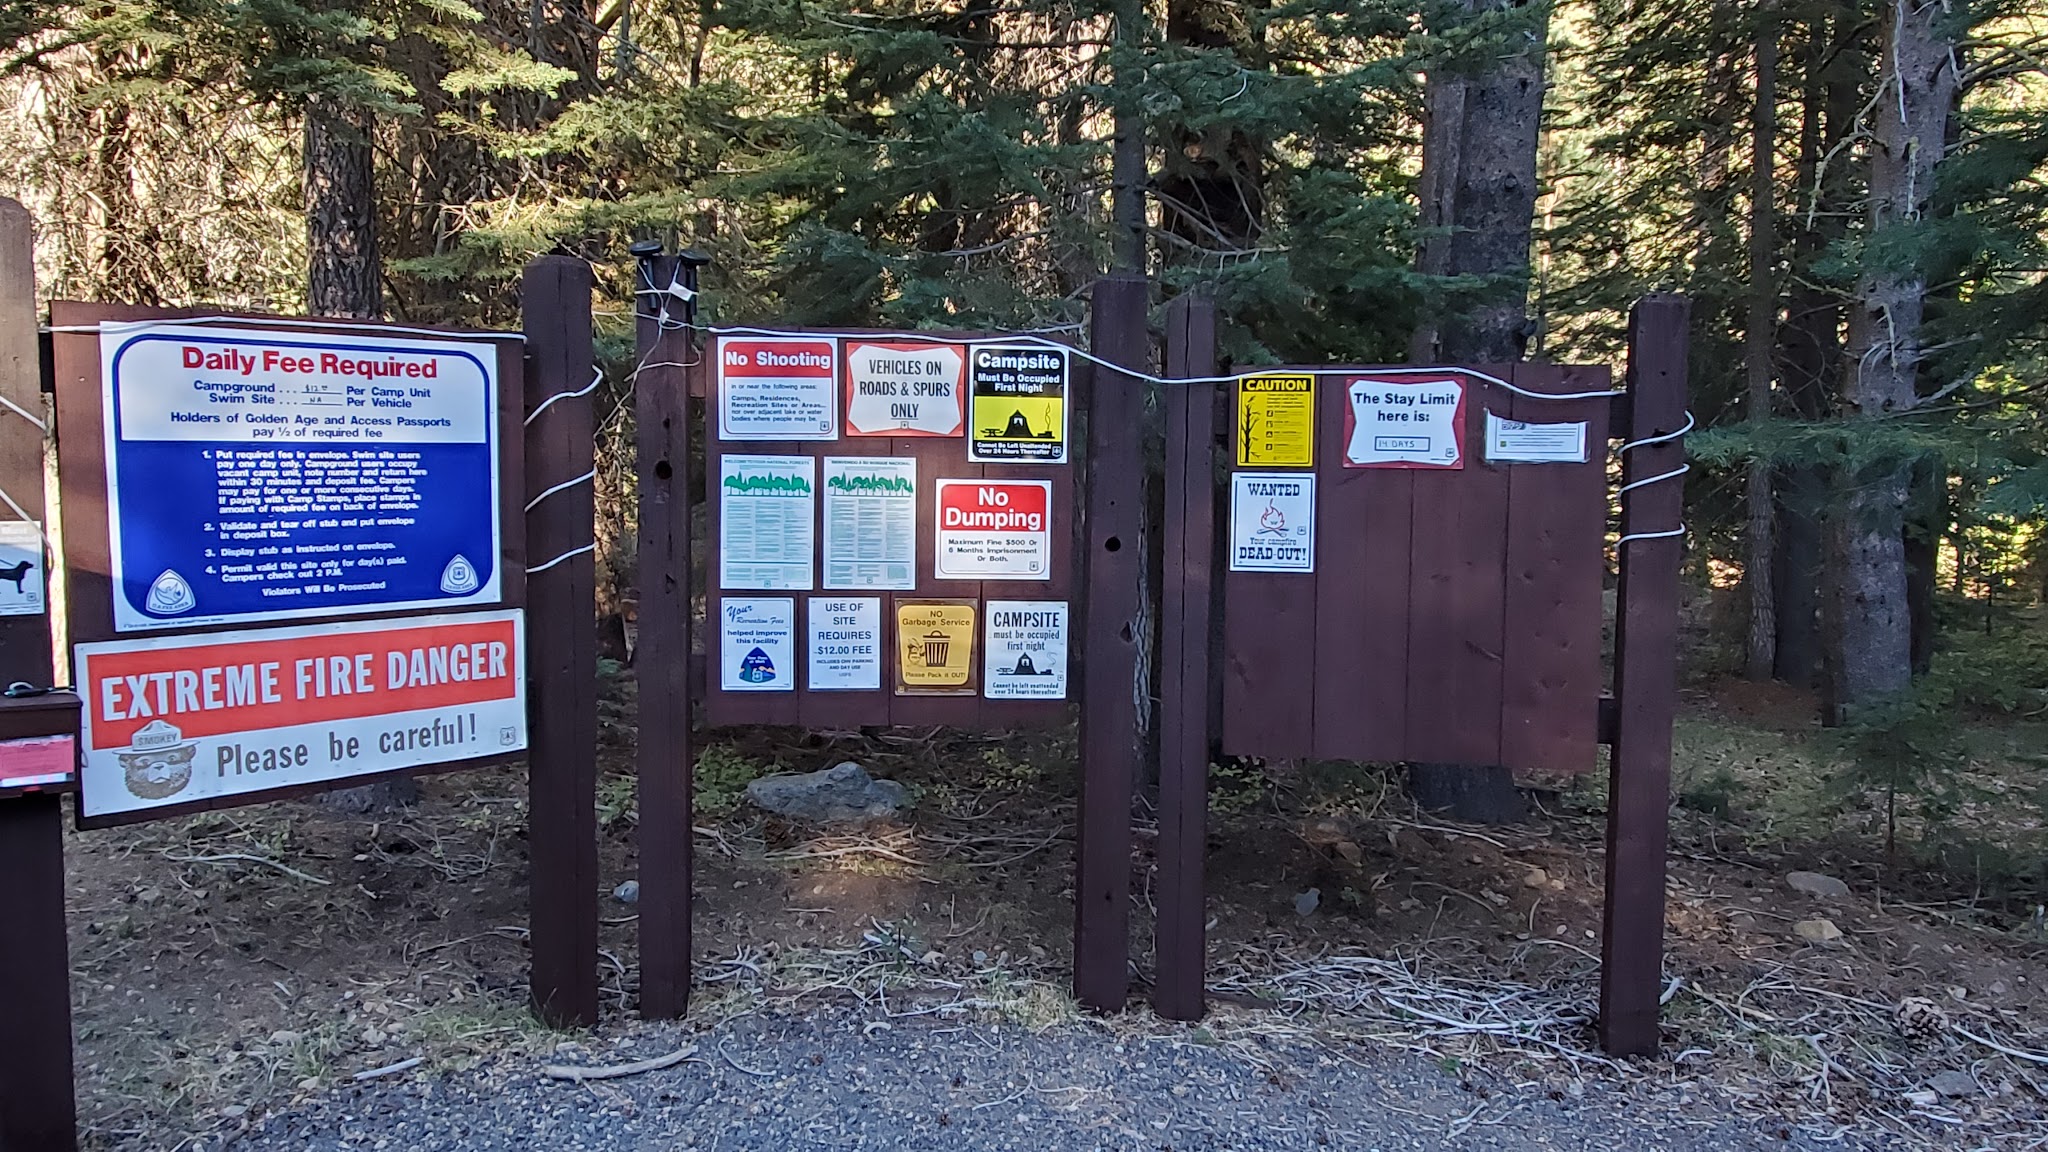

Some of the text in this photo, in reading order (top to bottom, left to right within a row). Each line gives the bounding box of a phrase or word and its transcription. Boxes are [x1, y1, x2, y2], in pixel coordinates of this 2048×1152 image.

[182, 346, 437, 380] Daily Fee Required
[725, 351, 831, 370] No Shooting
[869, 359, 942, 376] VEHICLES ON
[978, 352, 1060, 372] Campsite
[977, 372, 1060, 384] Must Be Occupied
[1246, 379, 1307, 391] CAUTION
[194, 380, 275, 393] Campground
[346, 386, 366, 396] Per
[371, 387, 404, 398] Camp
[410, 388, 431, 398] Unit
[773, 383, 798, 391] following
[859, 381, 951, 397] ROADS & SPURS
[994, 383, 1043, 394] First Night
[209, 393, 245, 403] Swim
[251, 394, 275, 404] Site
[347, 397, 366, 407] Per
[372, 398, 412, 408] Vehicle
[1354, 392, 1456, 406] The Stay Limit
[890, 403, 919, 418] ONLY
[1377, 410, 1430, 422] here is:
[171, 412, 451, 428] Holders of Golden Age and Access Passports
[253, 428, 274, 438] pay
[294, 427, 306, 437] of
[313, 428, 359, 439] required
[365, 429, 383, 437] fee
[1391, 440, 1415, 448] DAYS
[978, 487, 1009, 506] No
[1247, 483, 1300, 496] WANTED
[204, 517, 415, 531] 2. Validate and tear off stub and put envelope
[945, 507, 1041, 531] Dumping
[220, 529, 290, 540] in deposit box.
[1249, 537, 1297, 546] Your campfire
[204, 549, 216, 558] 3.
[221, 548, 255, 557] Display
[258, 546, 279, 555] stub
[296, 544, 340, 553] instructed
[356, 542, 396, 551] envelope.
[987, 547, 1037, 555] Imprisonment
[1239, 546, 1307, 561] DEAD-OUT!
[205, 566, 217, 574] 4.
[221, 564, 253, 573] Permit
[256, 563, 278, 571] valid
[280, 562, 297, 570] this
[301, 561, 318, 569] site
[342, 559, 355, 567] for
[386, 557, 407, 566] paid.
[262, 581, 386, 597] Violators Will Be Prosecuted
[726, 605, 753, 623] Your
[825, 603, 864, 612] USE OF
[929, 610, 943, 618] NO
[832, 616, 856, 626] SITE
[902, 618, 971, 628] Garbage Service
[993, 612, 1060, 628] CAMPSITE
[727, 629, 754, 637] helped
[818, 631, 872, 641] REQUIRES
[993, 630, 1060, 641] must be occupied
[817, 646, 872, 656] $12.00 FEE
[1007, 641, 1045, 652] first night
[102, 641, 507, 721] EXTREME FIRE DANGER
[138, 732, 178, 746] SMOKEY
[217, 713, 476, 777] Please be careful!
